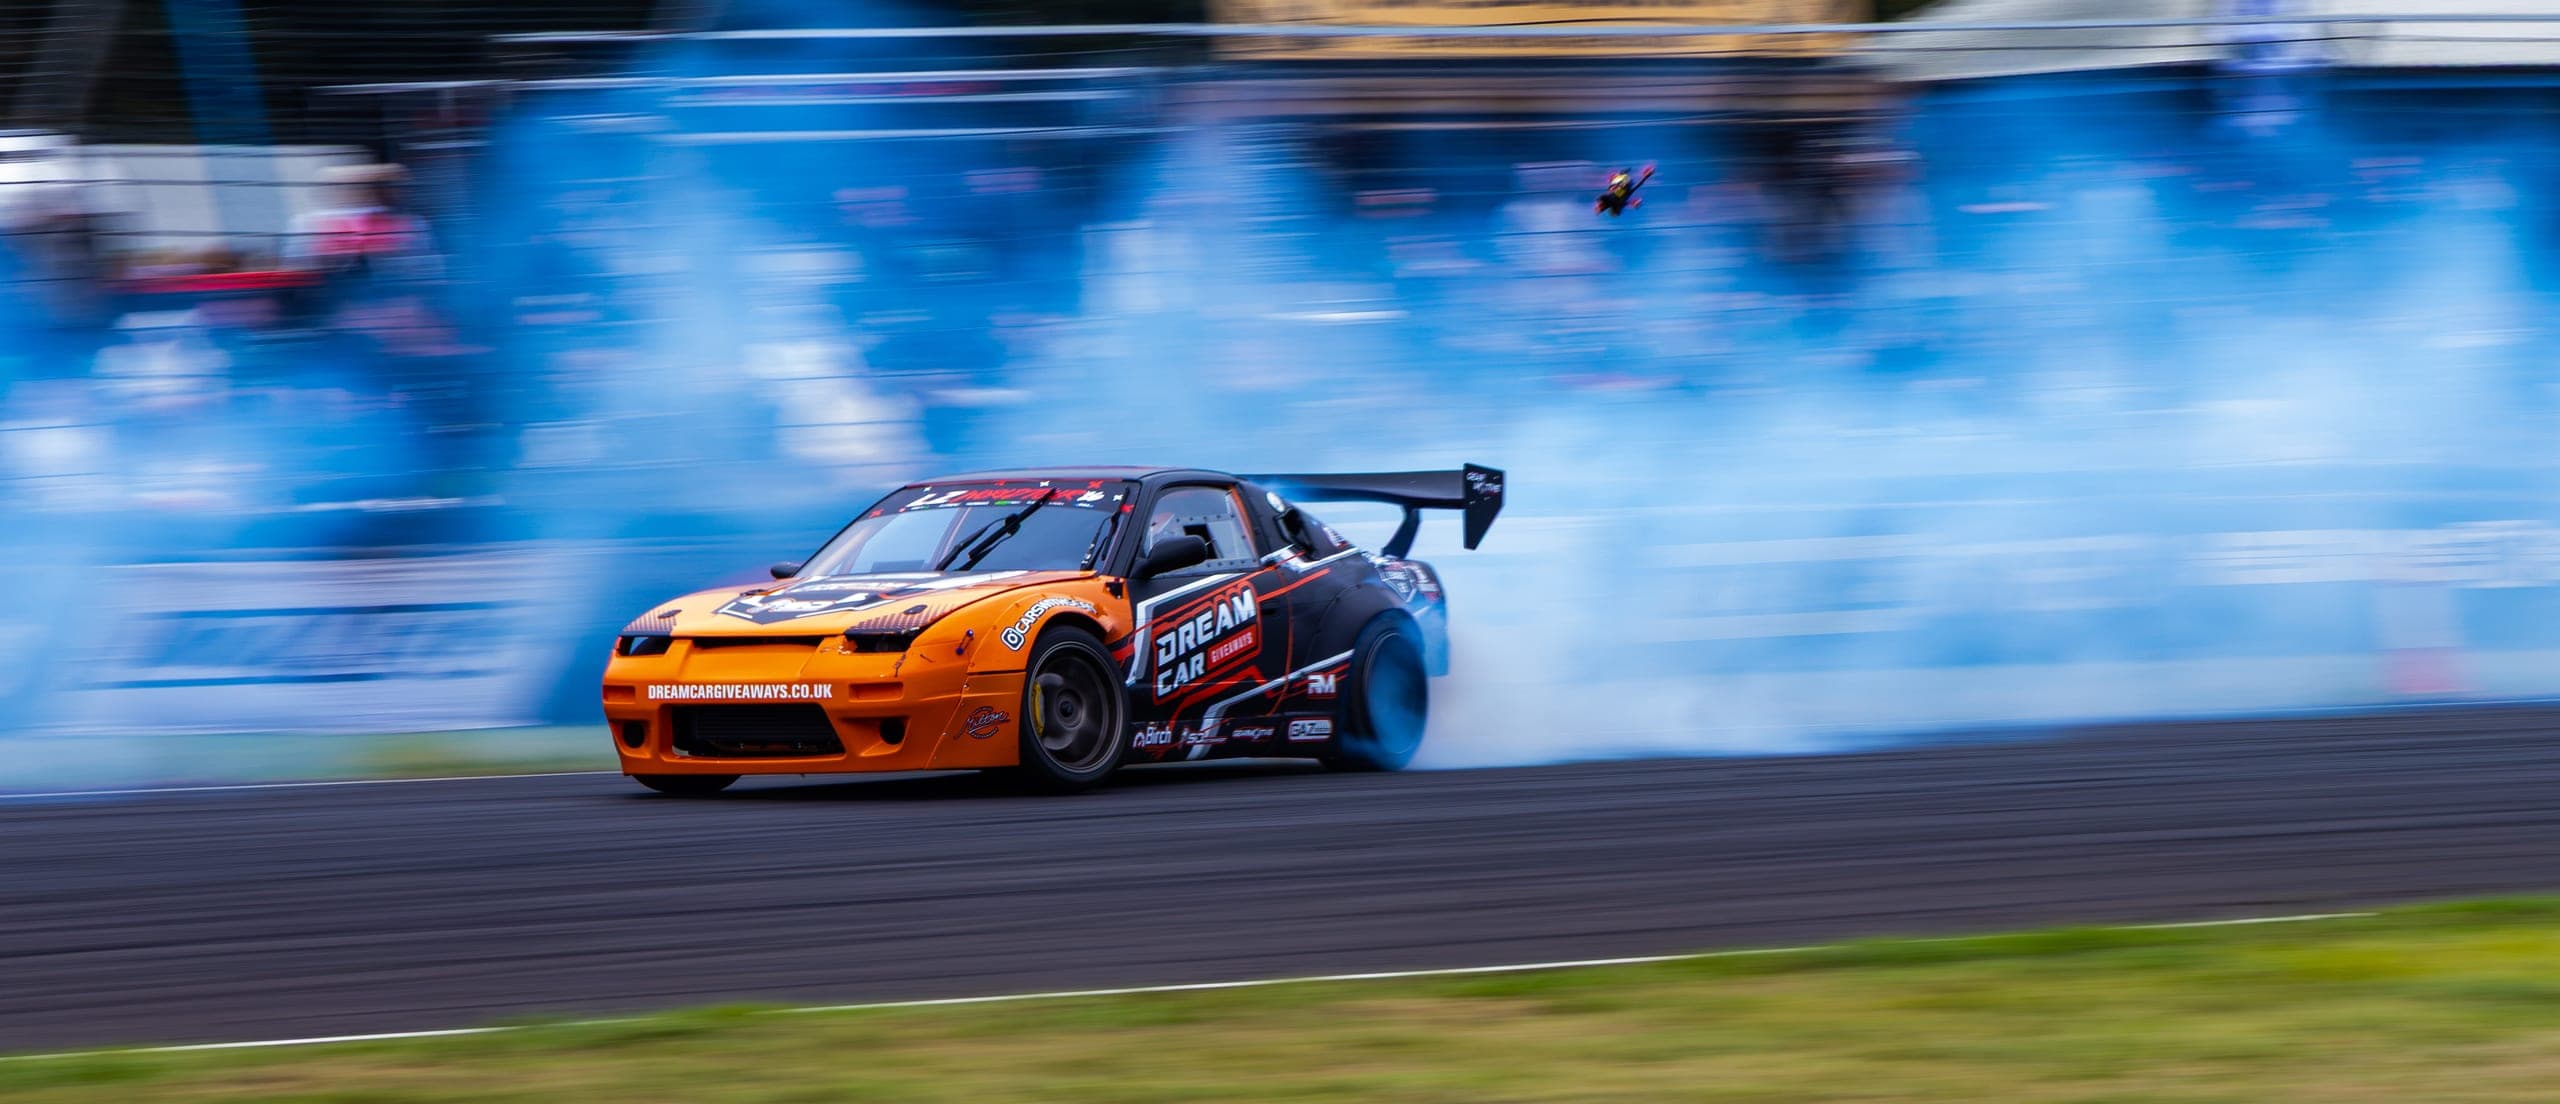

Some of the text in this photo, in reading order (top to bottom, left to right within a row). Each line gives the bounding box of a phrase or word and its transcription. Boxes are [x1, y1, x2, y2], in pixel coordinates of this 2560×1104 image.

[1156, 589, 1257, 668] DREAM
[647, 683, 833, 699] DREAMCARGIVEAWAYS.CO.UK
[1157, 652, 1205, 697] CAR
